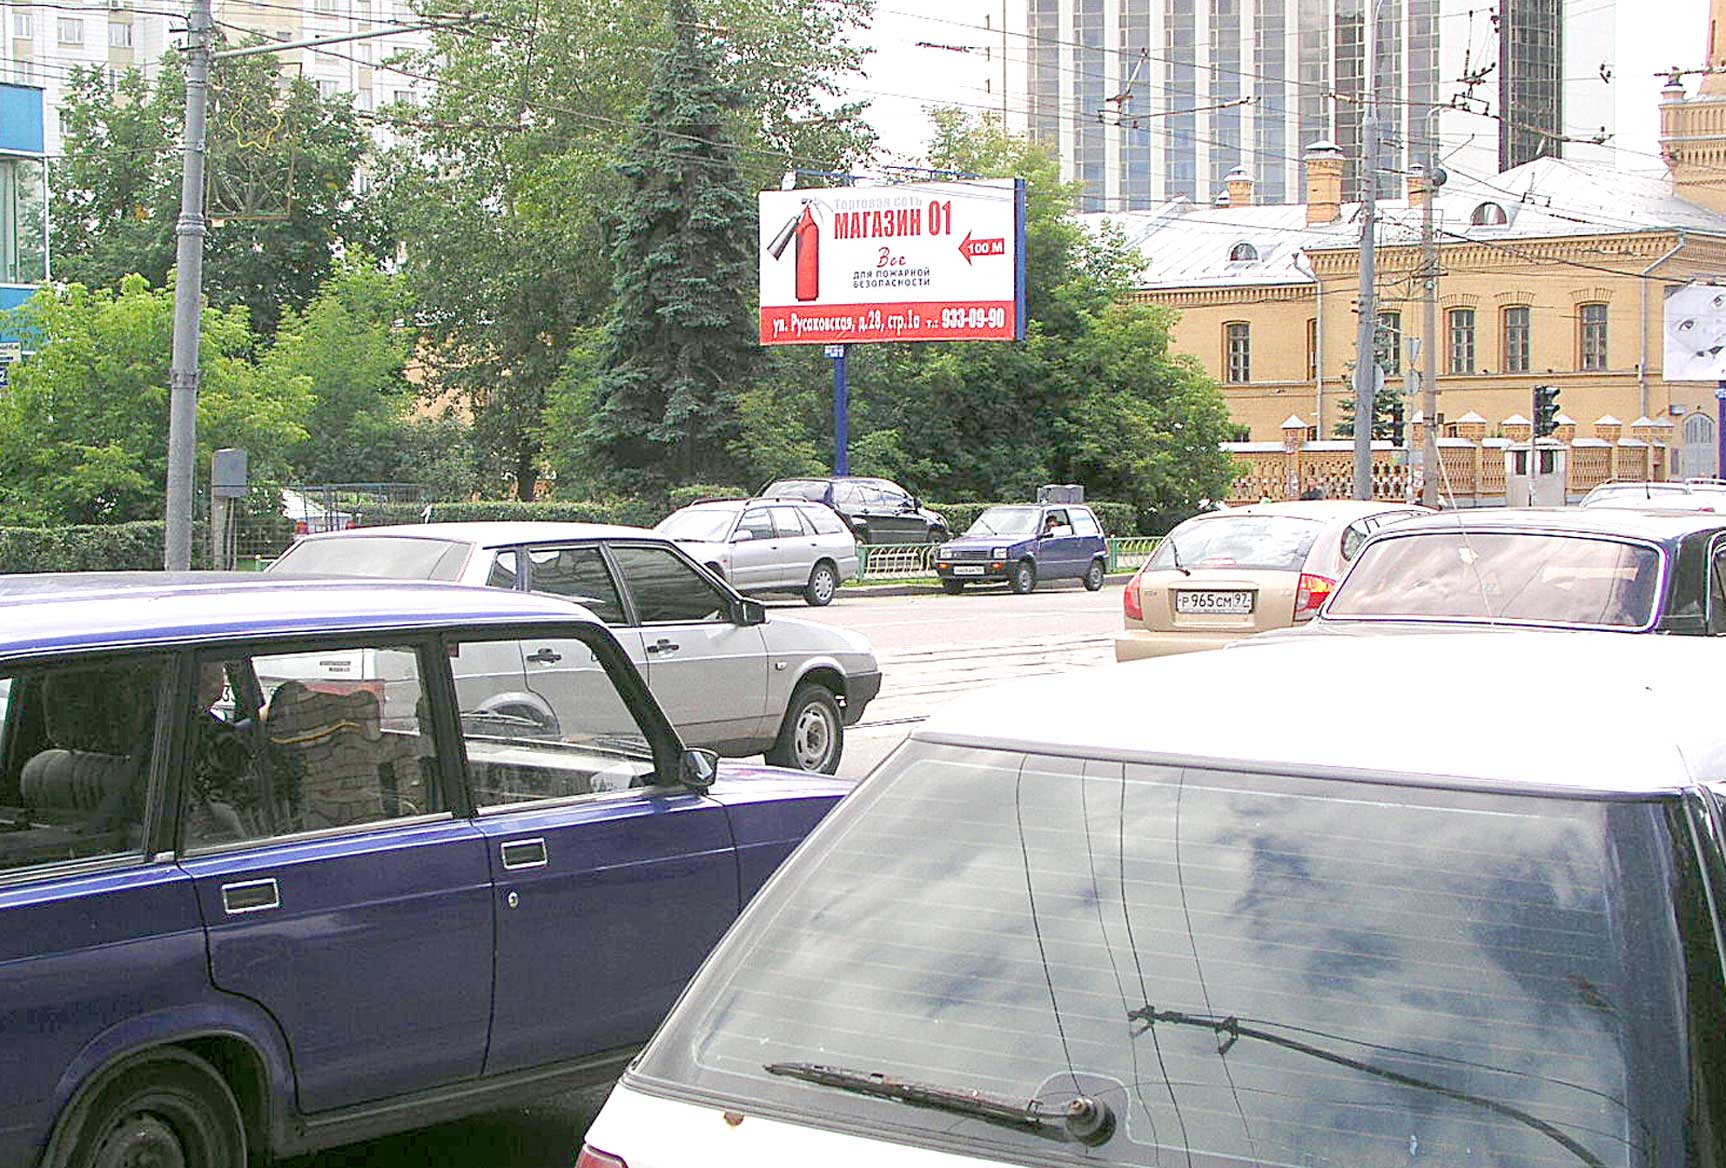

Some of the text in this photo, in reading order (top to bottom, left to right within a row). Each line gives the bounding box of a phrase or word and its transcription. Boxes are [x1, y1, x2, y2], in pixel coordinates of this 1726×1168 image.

[834, 199, 951, 240] МАГАЗИН 01
[968, 242, 989, 254] 100
[876, 246, 906, 268] Все
[876, 266, 930, 278] ПОЖАРНОЙ
[853, 278, 930, 288] БЕЗОПАСНОСТИ
[772, 318, 788, 338] ул.
[941, 307, 1005, 329] 933-09-90
